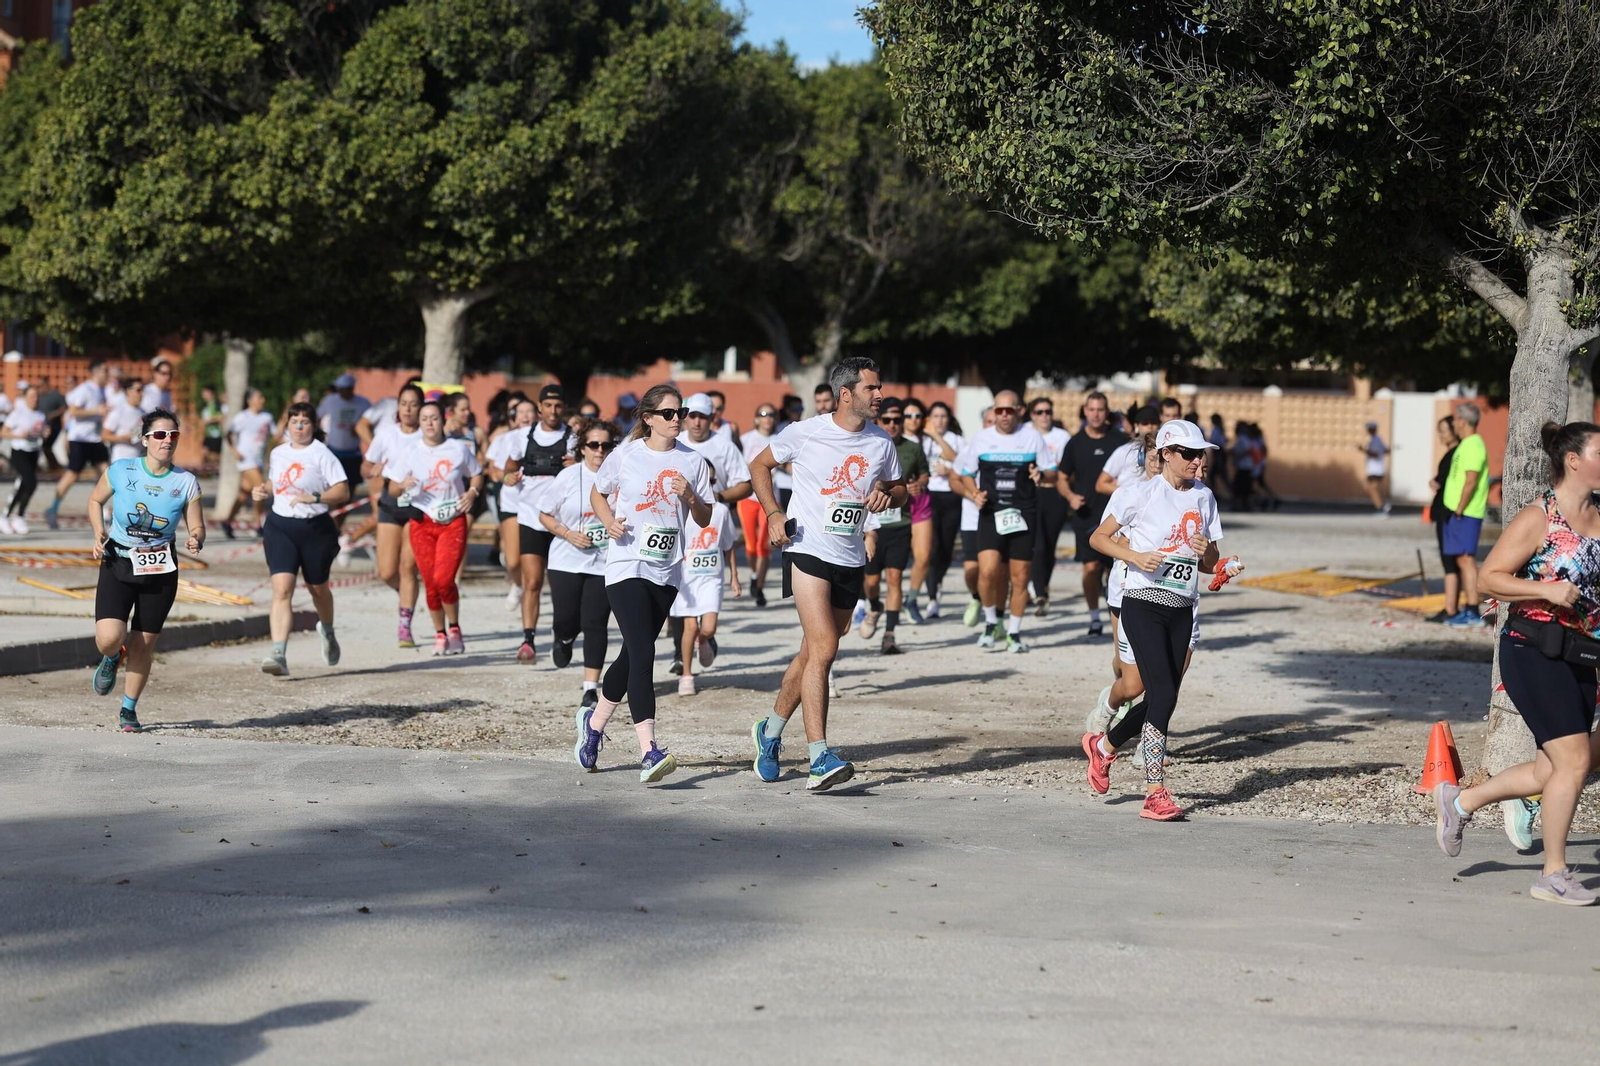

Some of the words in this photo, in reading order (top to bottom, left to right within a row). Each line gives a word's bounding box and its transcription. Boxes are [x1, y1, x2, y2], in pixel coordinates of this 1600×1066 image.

[831, 508, 862, 525] 690
[1003, 514, 1020, 526] 613
[647, 533, 676, 550] 689
[137, 552, 167, 566] 392
[692, 555, 718, 568] 959
[1162, 562, 1193, 581] 783
[1429, 761, 1449, 773] DPT
